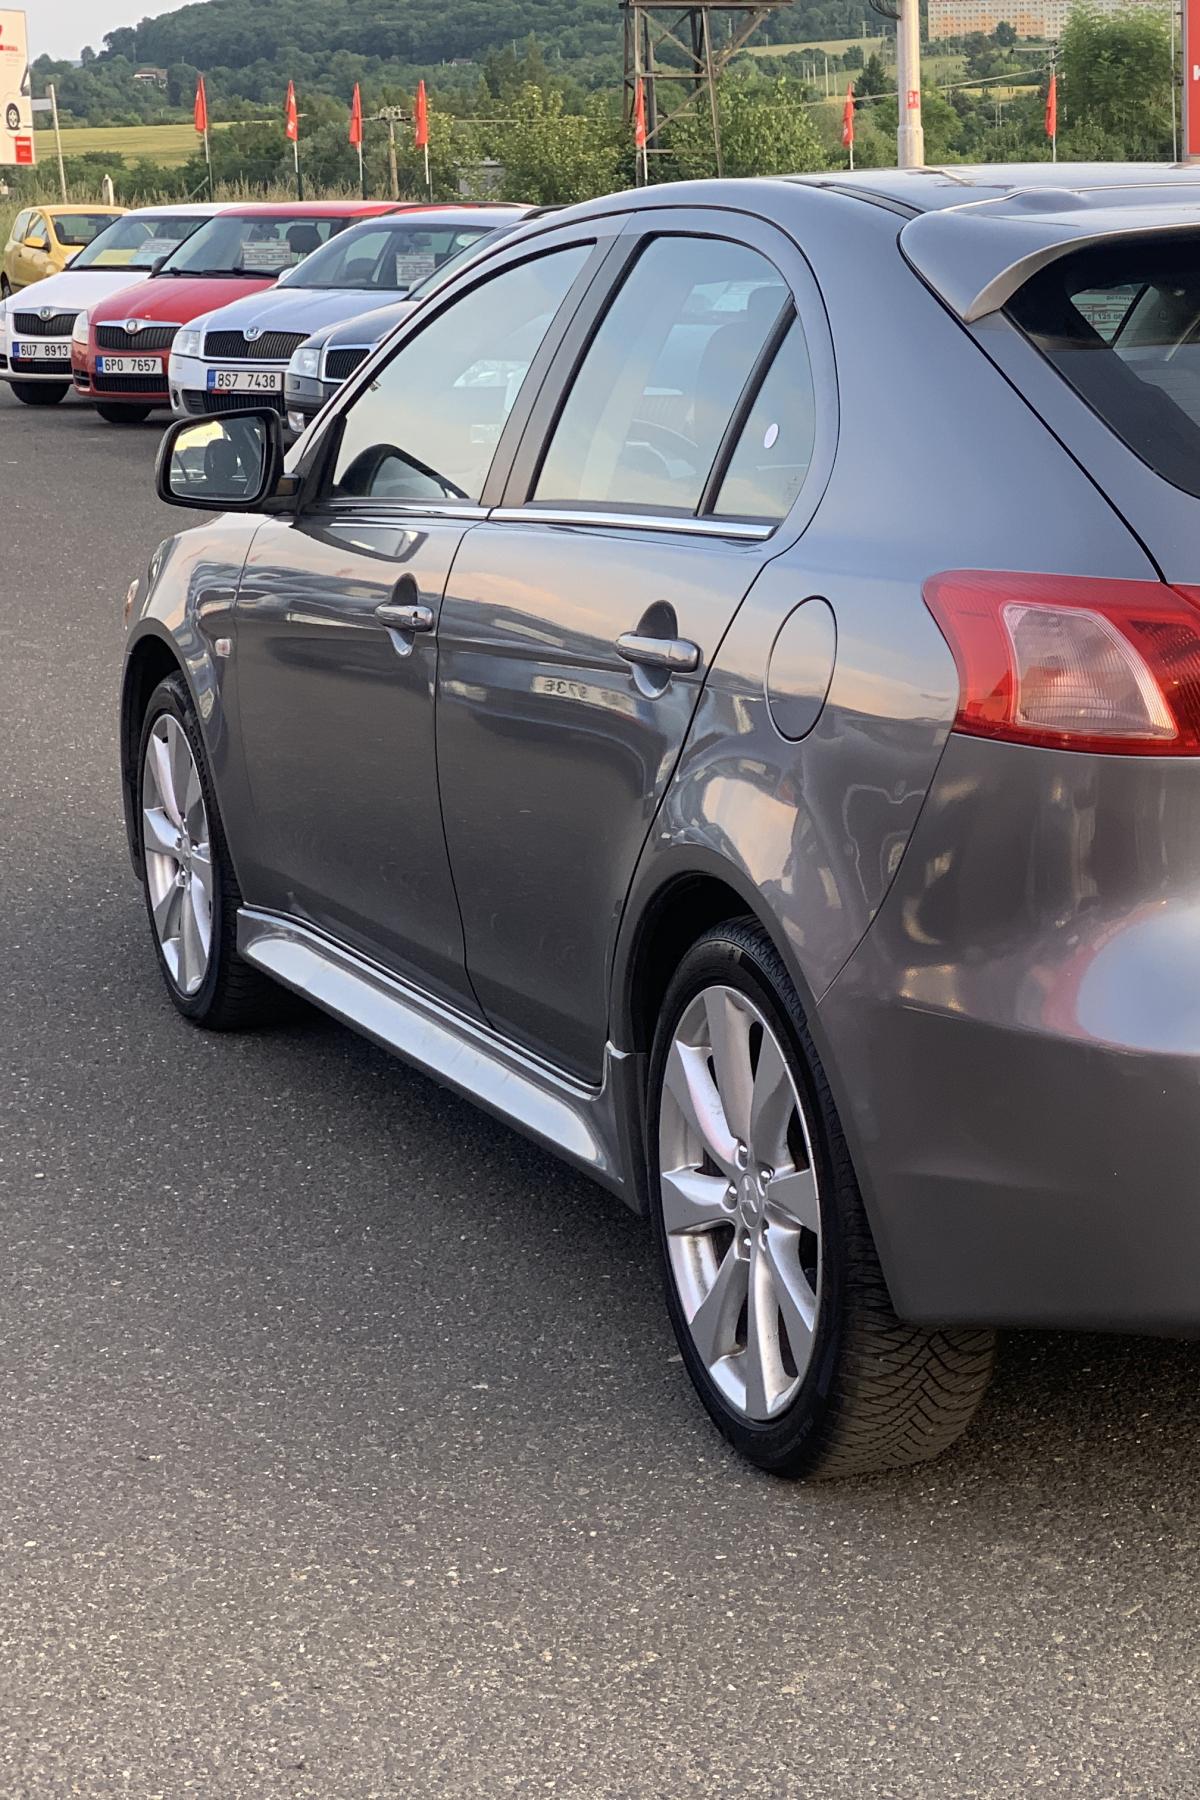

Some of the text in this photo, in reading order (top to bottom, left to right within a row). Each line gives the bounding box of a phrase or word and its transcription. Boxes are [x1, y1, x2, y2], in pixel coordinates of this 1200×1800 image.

[21, 343, 68, 356] 6U7 8913
[131, 359, 157, 372] 7657
[217, 374, 276, 388] 8S7 7438
